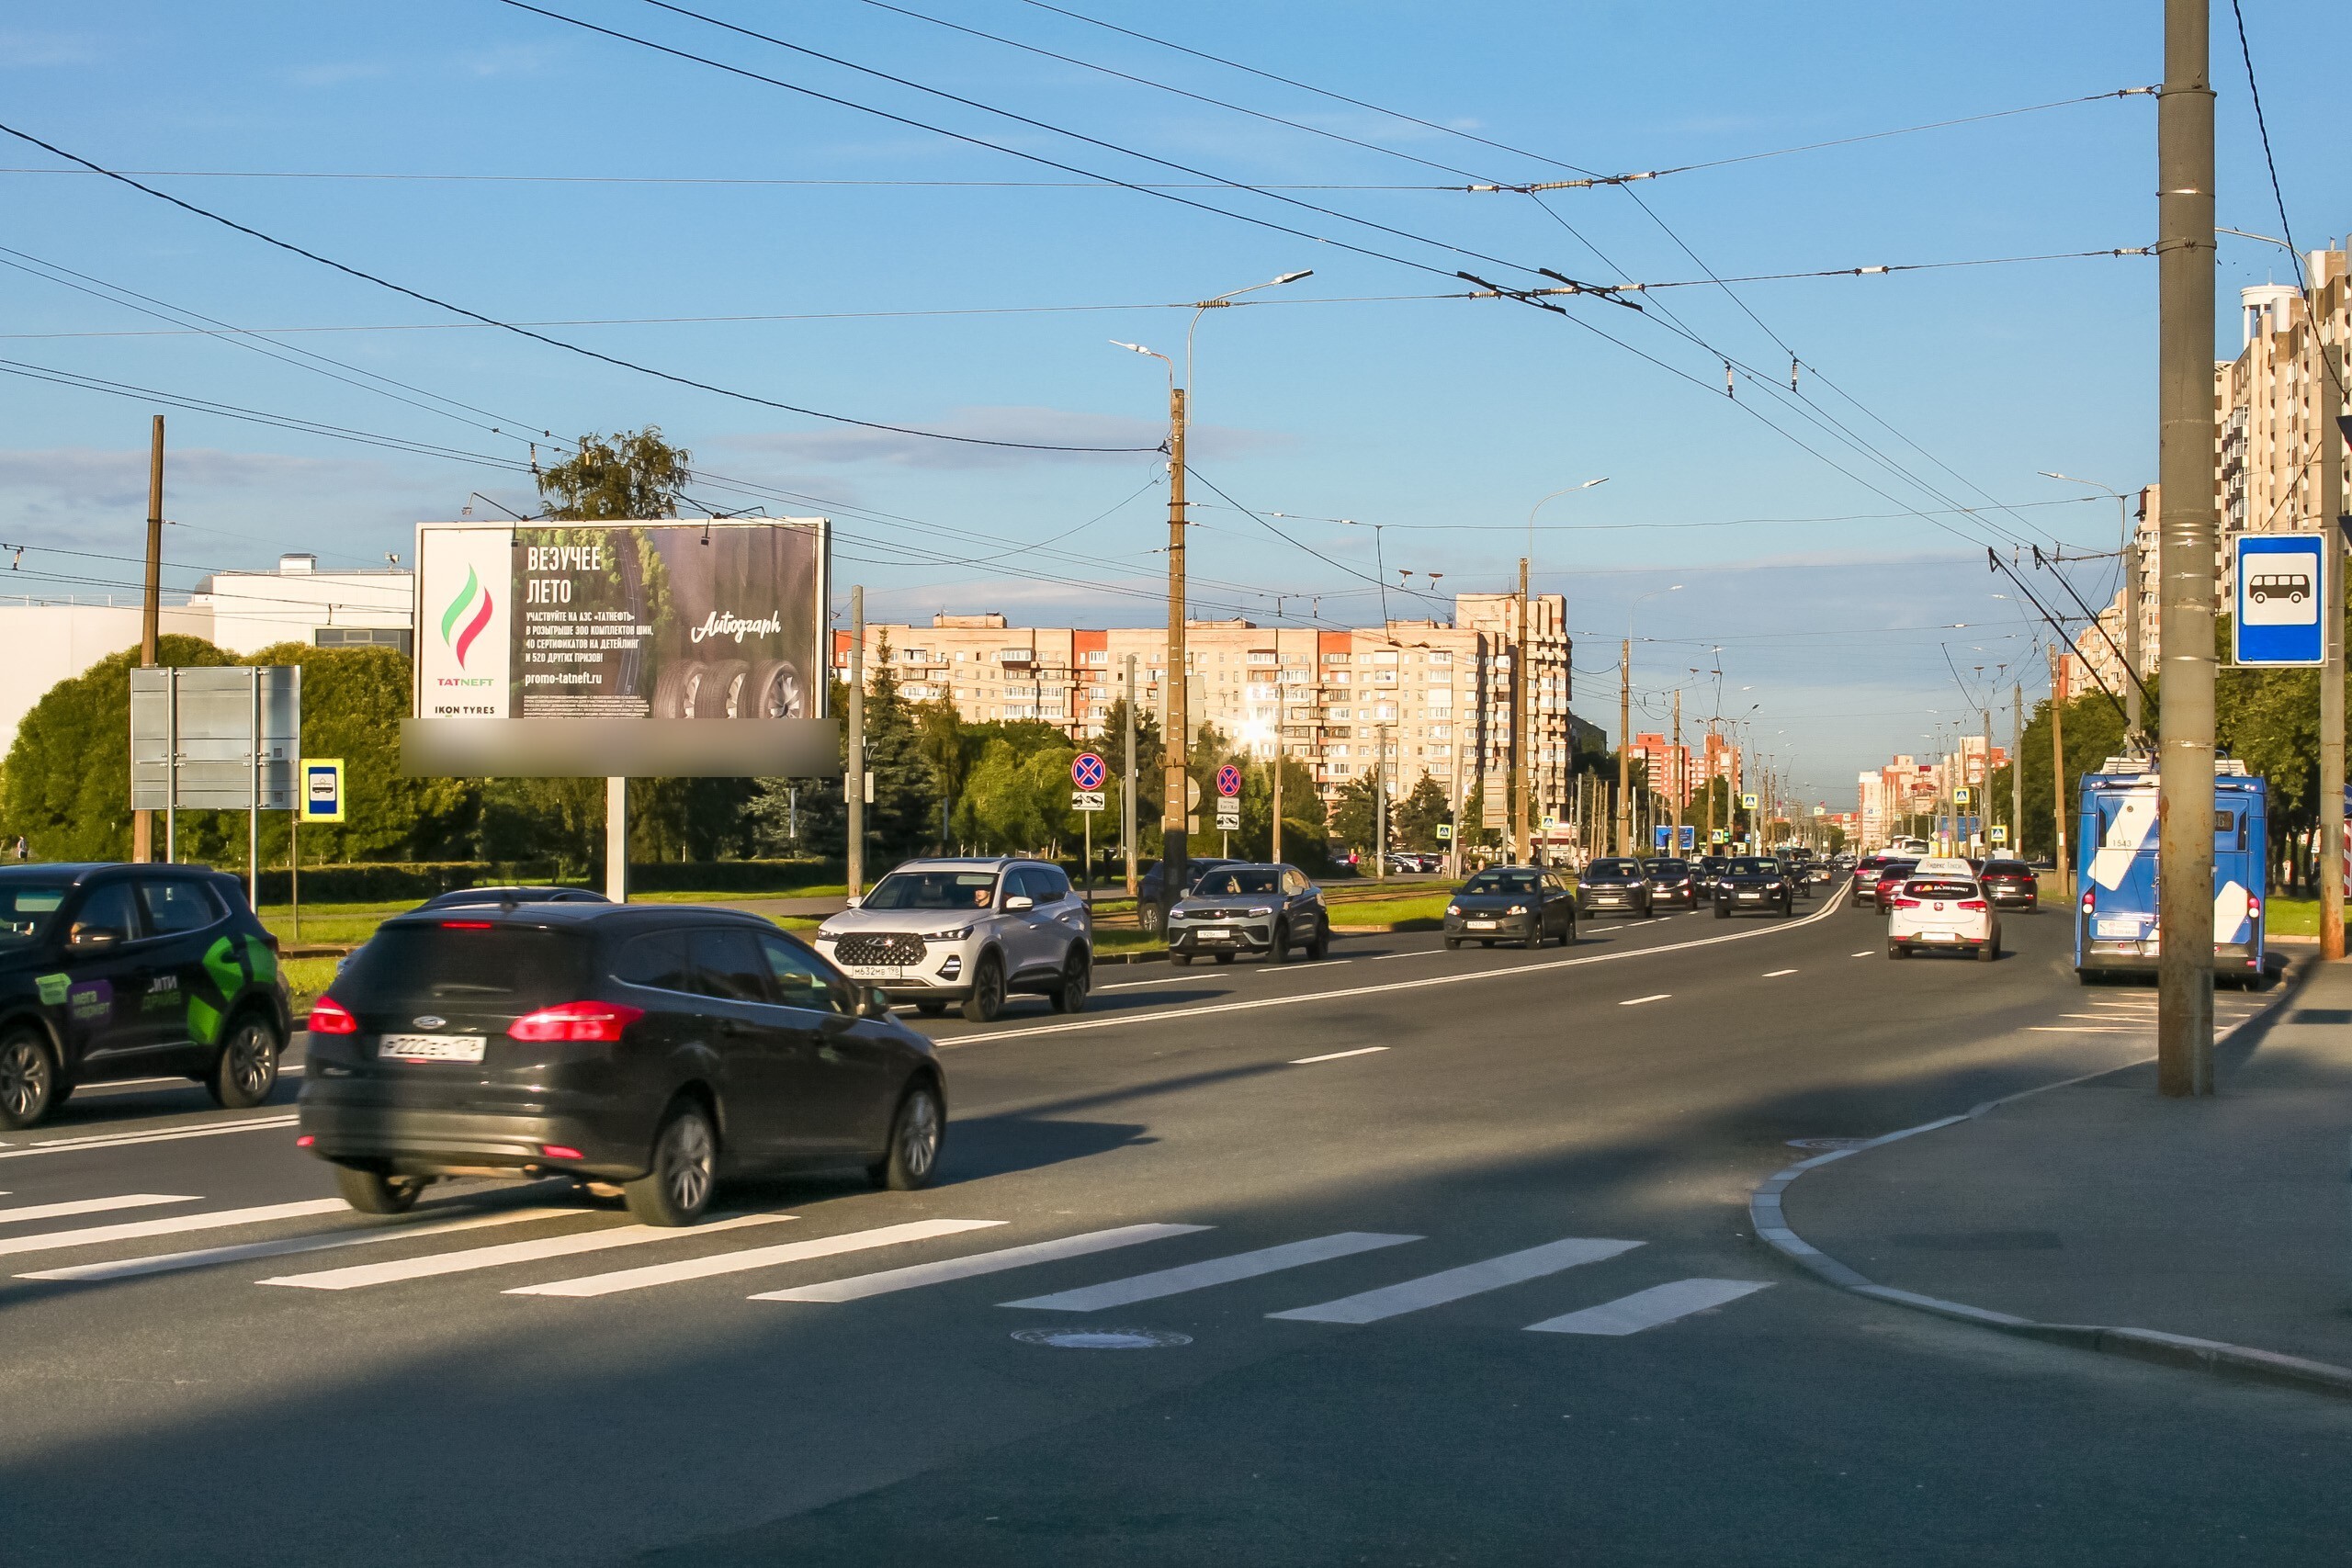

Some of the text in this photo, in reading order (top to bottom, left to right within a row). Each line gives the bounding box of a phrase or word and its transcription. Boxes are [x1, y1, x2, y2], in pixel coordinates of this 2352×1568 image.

[527, 546, 601, 571] ВЕЗУЧЕЕ
[526, 579, 571, 604] ЛЕТО
[526, 610, 567, 622] УЧАСТВУЙТЕ
[568, 612, 577, 622] НА
[579, 612, 593, 622] АЗС
[526, 626, 531, 636] В
[532, 626, 574, 636] РОЗЫГРЫШЕ
[590, 626, 635, 636] КОМПЛЕКТОВ
[636, 626, 654, 636] ШИН,
[690, 610, 781, 643] Autograph
[526, 637, 639, 650] 40 СЕРТИФИКАТОВ НА ДЕТЕЙЛИНГ
[525, 652, 604, 663] И 520 ДРУГИХ ПРИЗОВ!
[436, 678, 494, 687] TATNEFT
[525, 671, 603, 687] promo-tatneft.ru
[435, 705, 495, 715] IKON TYRES
[2112, 840, 2132, 848] 1543
